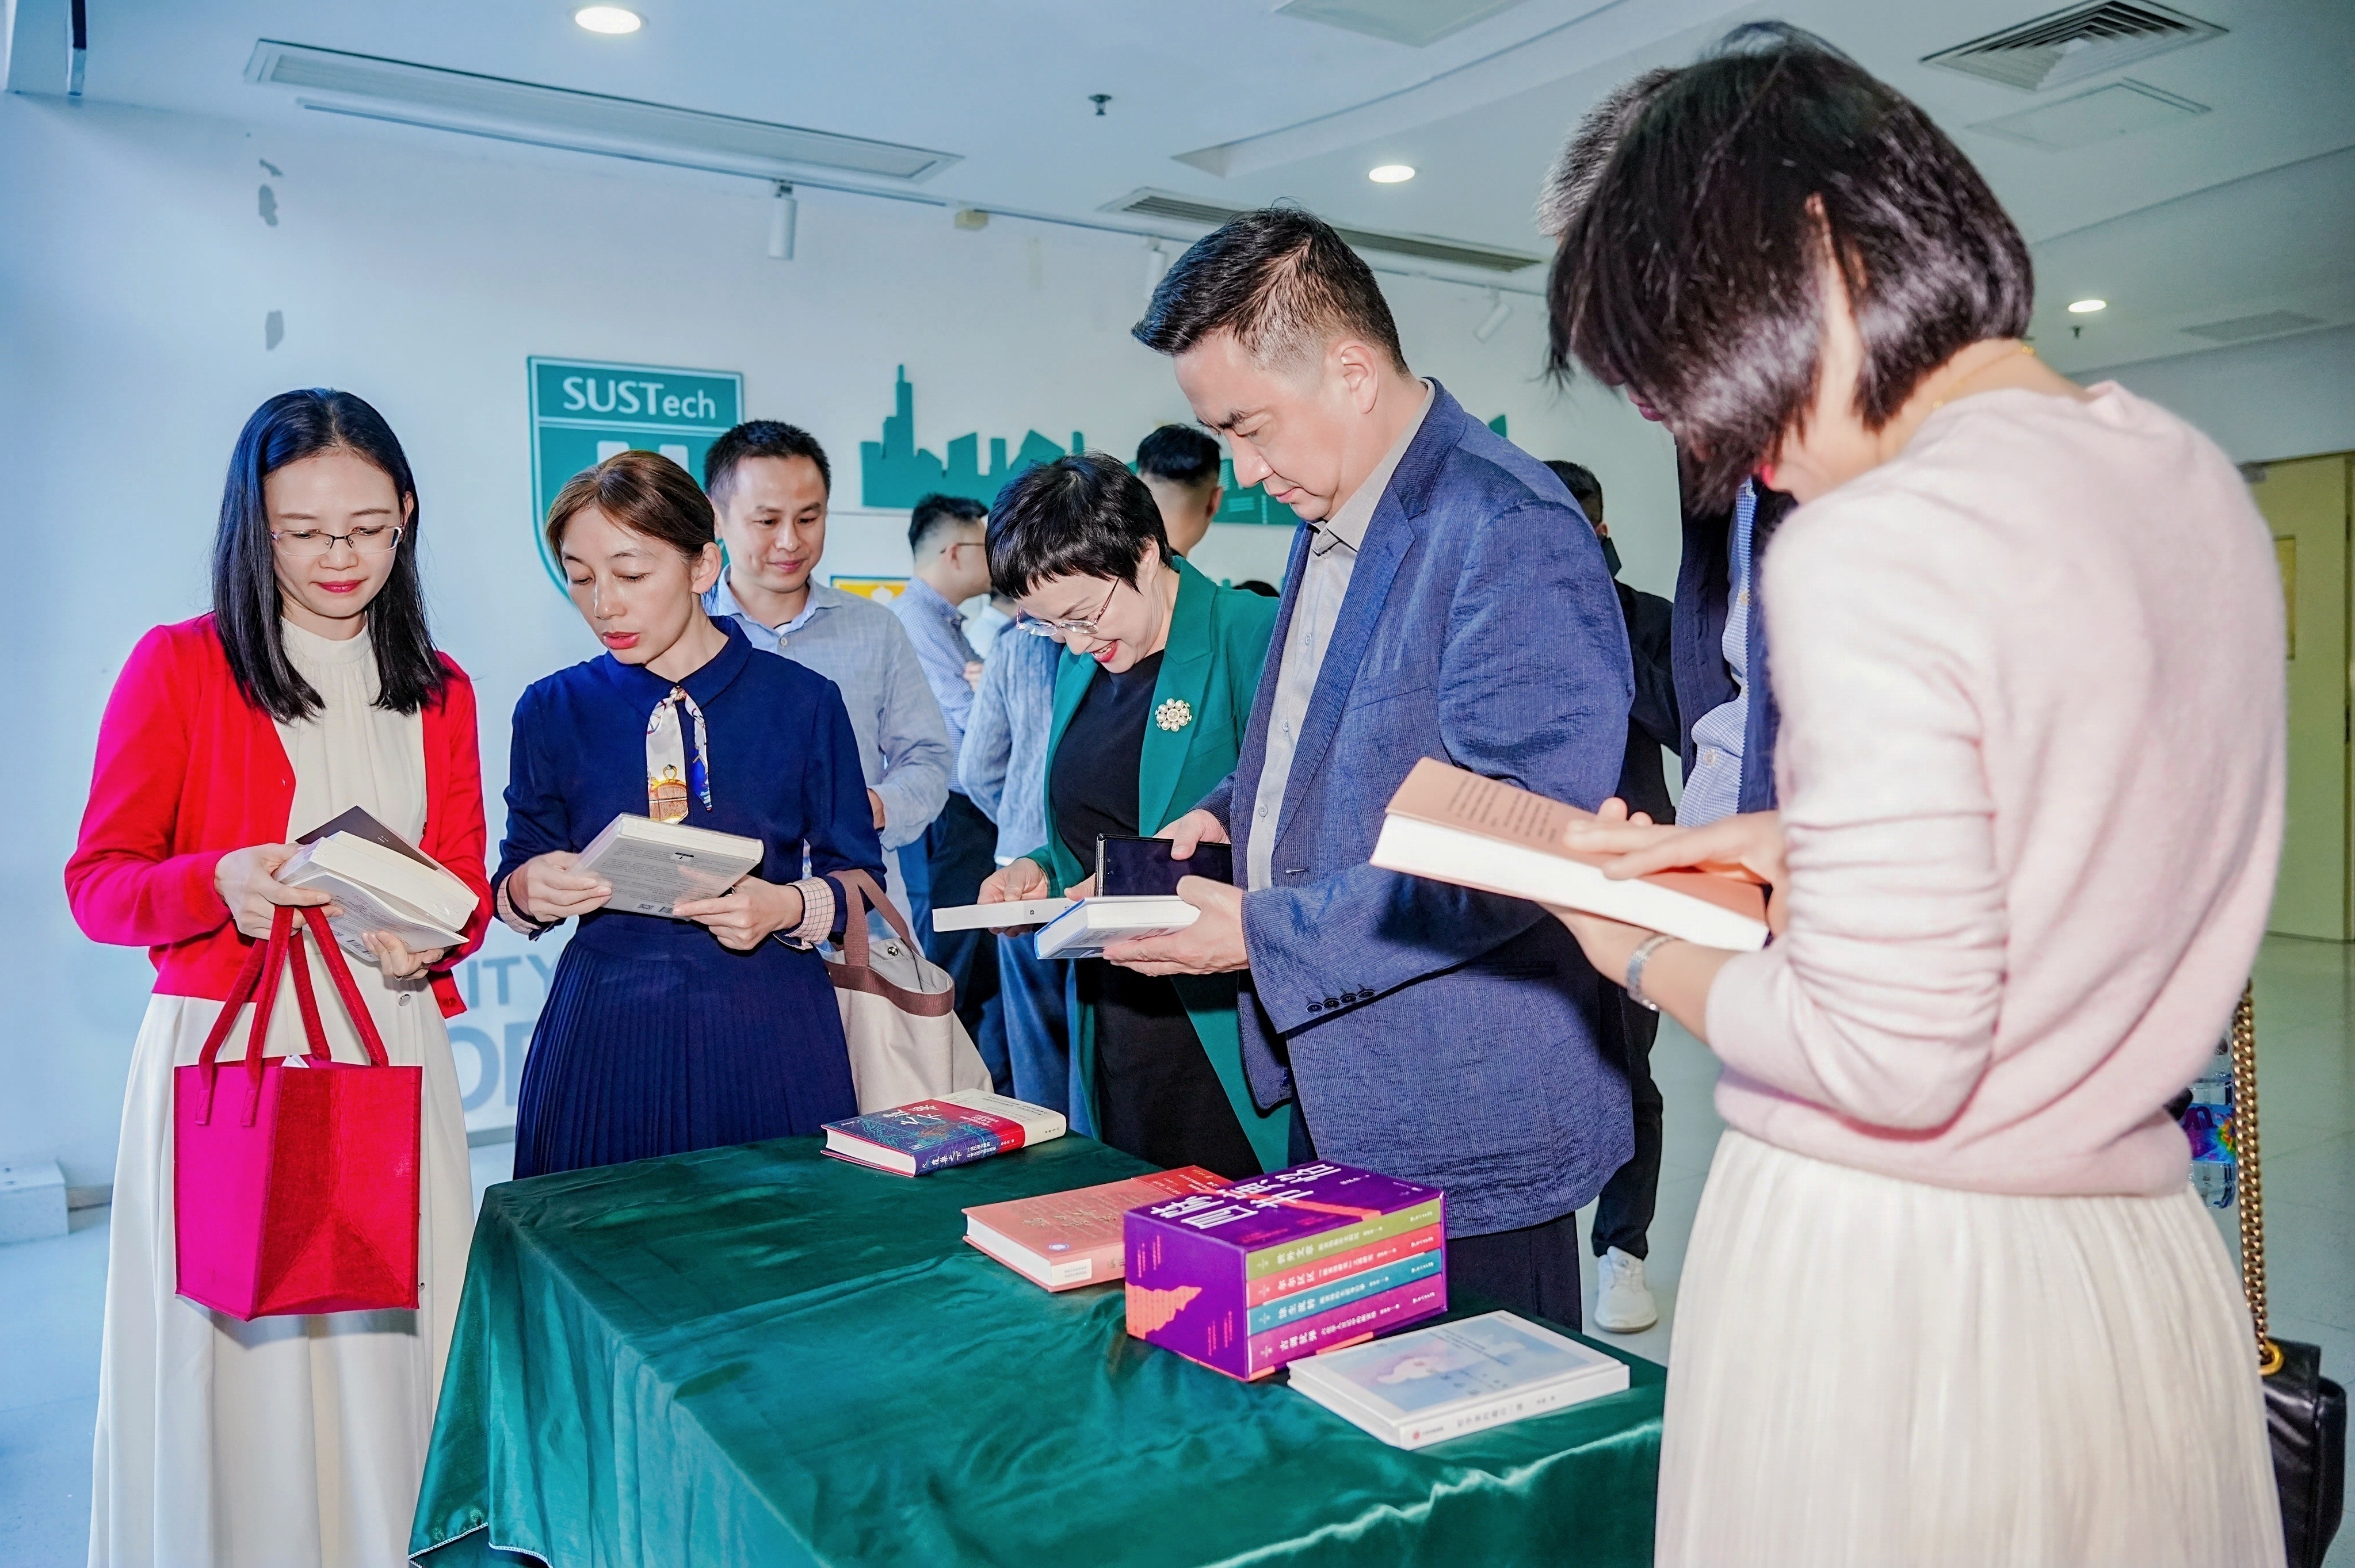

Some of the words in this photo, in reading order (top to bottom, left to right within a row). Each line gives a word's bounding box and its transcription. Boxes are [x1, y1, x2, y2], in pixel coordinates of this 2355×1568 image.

[563, 376, 716, 419] SUSTech
[1150, 1164, 1342, 1219] 陈寅恪
[1181, 1189, 1314, 1229] 四书
